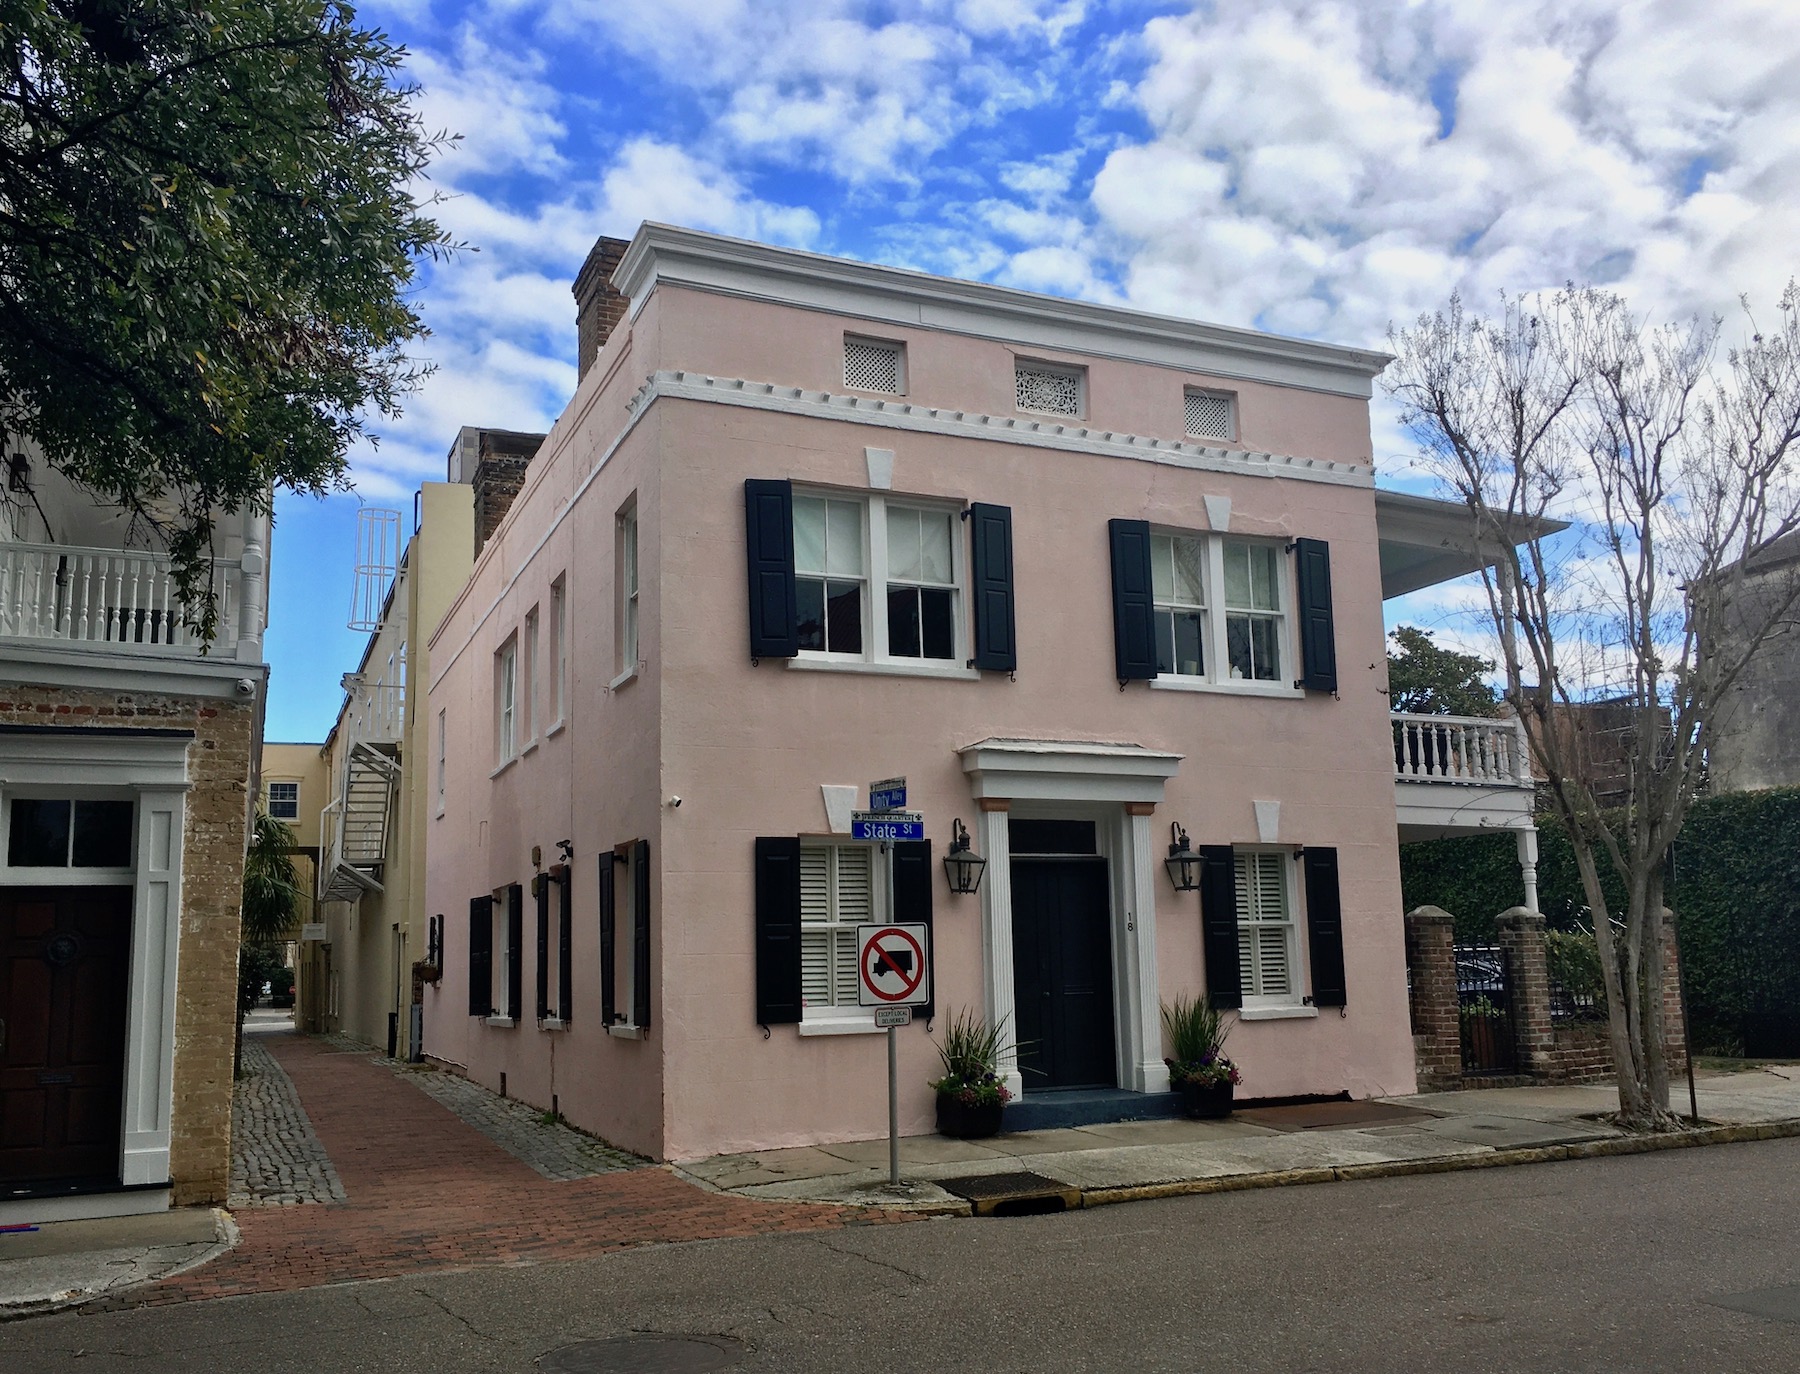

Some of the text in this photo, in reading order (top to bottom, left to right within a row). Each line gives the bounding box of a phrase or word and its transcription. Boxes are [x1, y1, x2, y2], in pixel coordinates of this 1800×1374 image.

[872, 792, 890, 808] Unity
[863, 822, 913, 838] State St
[1127, 912, 1134, 932] 18
